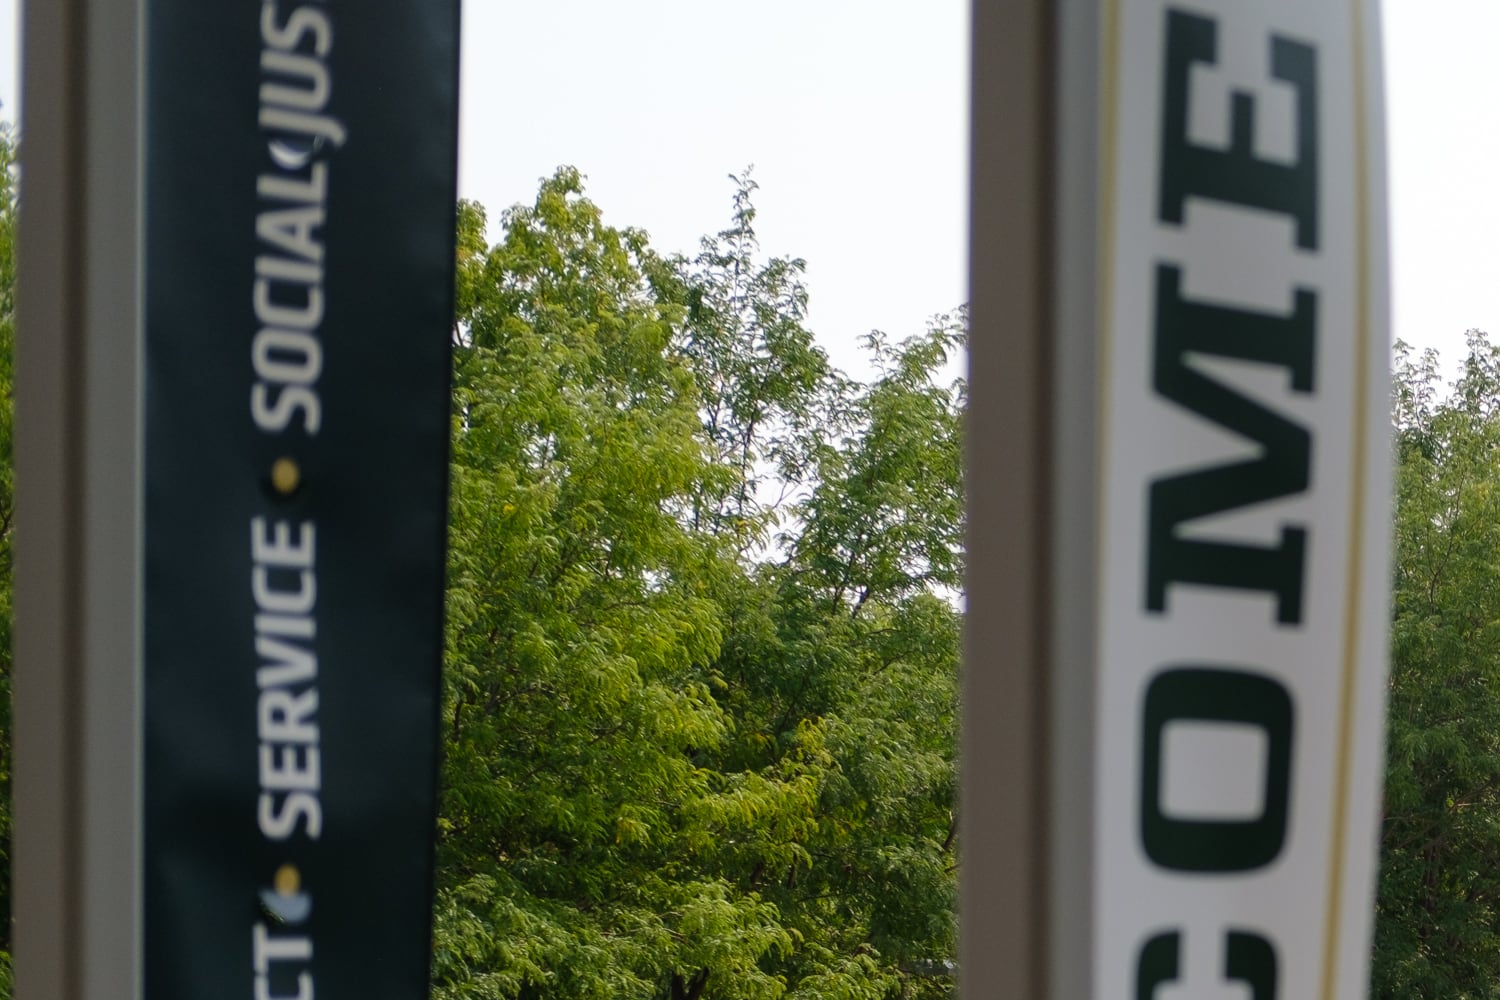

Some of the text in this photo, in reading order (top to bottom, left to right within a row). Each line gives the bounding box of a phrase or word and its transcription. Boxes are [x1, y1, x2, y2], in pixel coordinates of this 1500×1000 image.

[257, 0, 347, 148] JUS
[251, 162, 328, 434] SOCIAL
[251, 516, 320, 840] SERVICE
